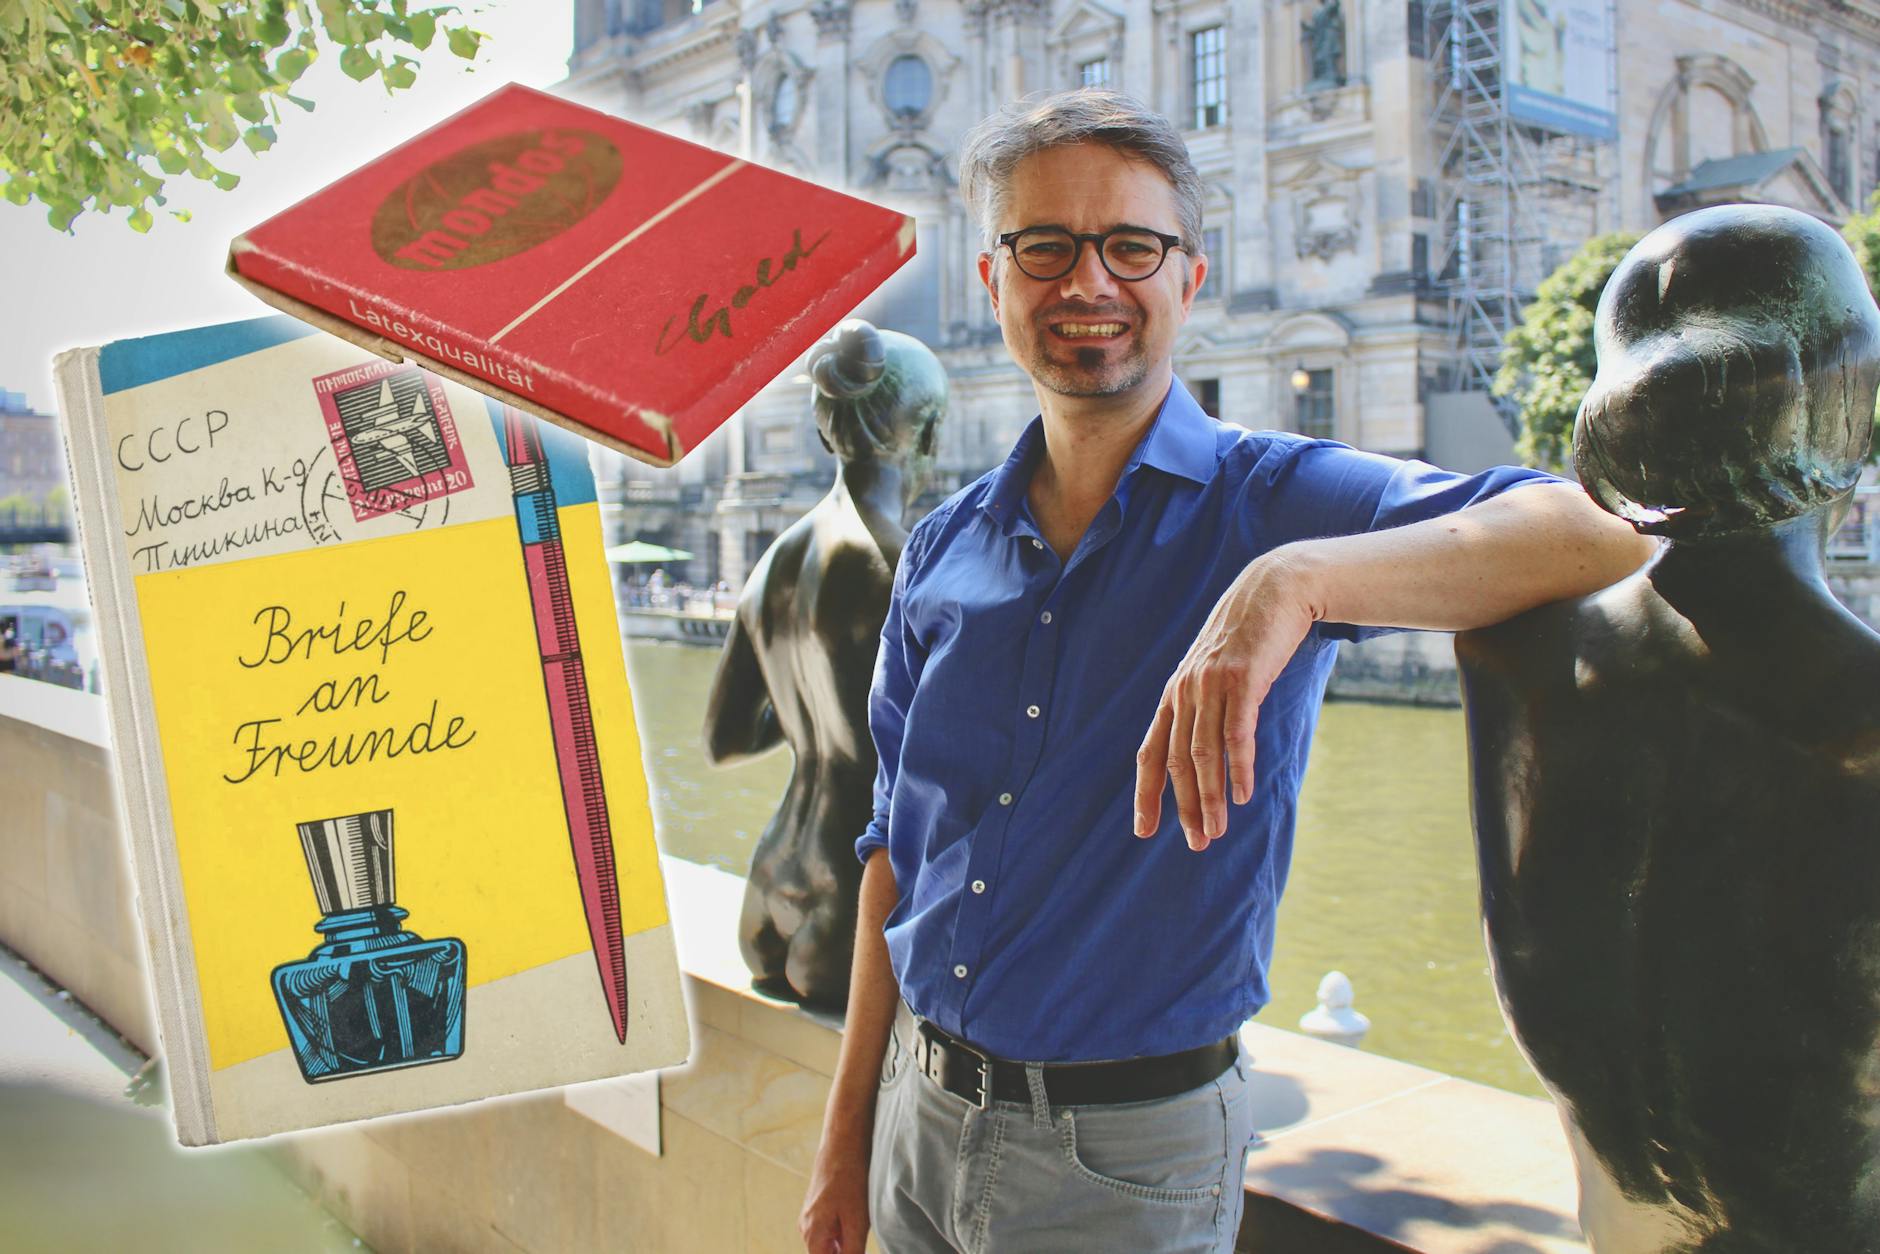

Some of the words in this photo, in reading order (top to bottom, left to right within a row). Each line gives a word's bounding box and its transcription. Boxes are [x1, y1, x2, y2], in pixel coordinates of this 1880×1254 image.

[393, 129, 586, 268] mondos
[655, 228, 832, 356] Gold
[349, 299, 536, 393] Latexqualität
[117, 410, 229, 471] СССР
[125, 476, 256, 536] Москва
[446, 470, 468, 490] 20
[238, 590, 433, 668] Briefe
[296, 673, 390, 716] an
[223, 699, 477, 784] Freunde
